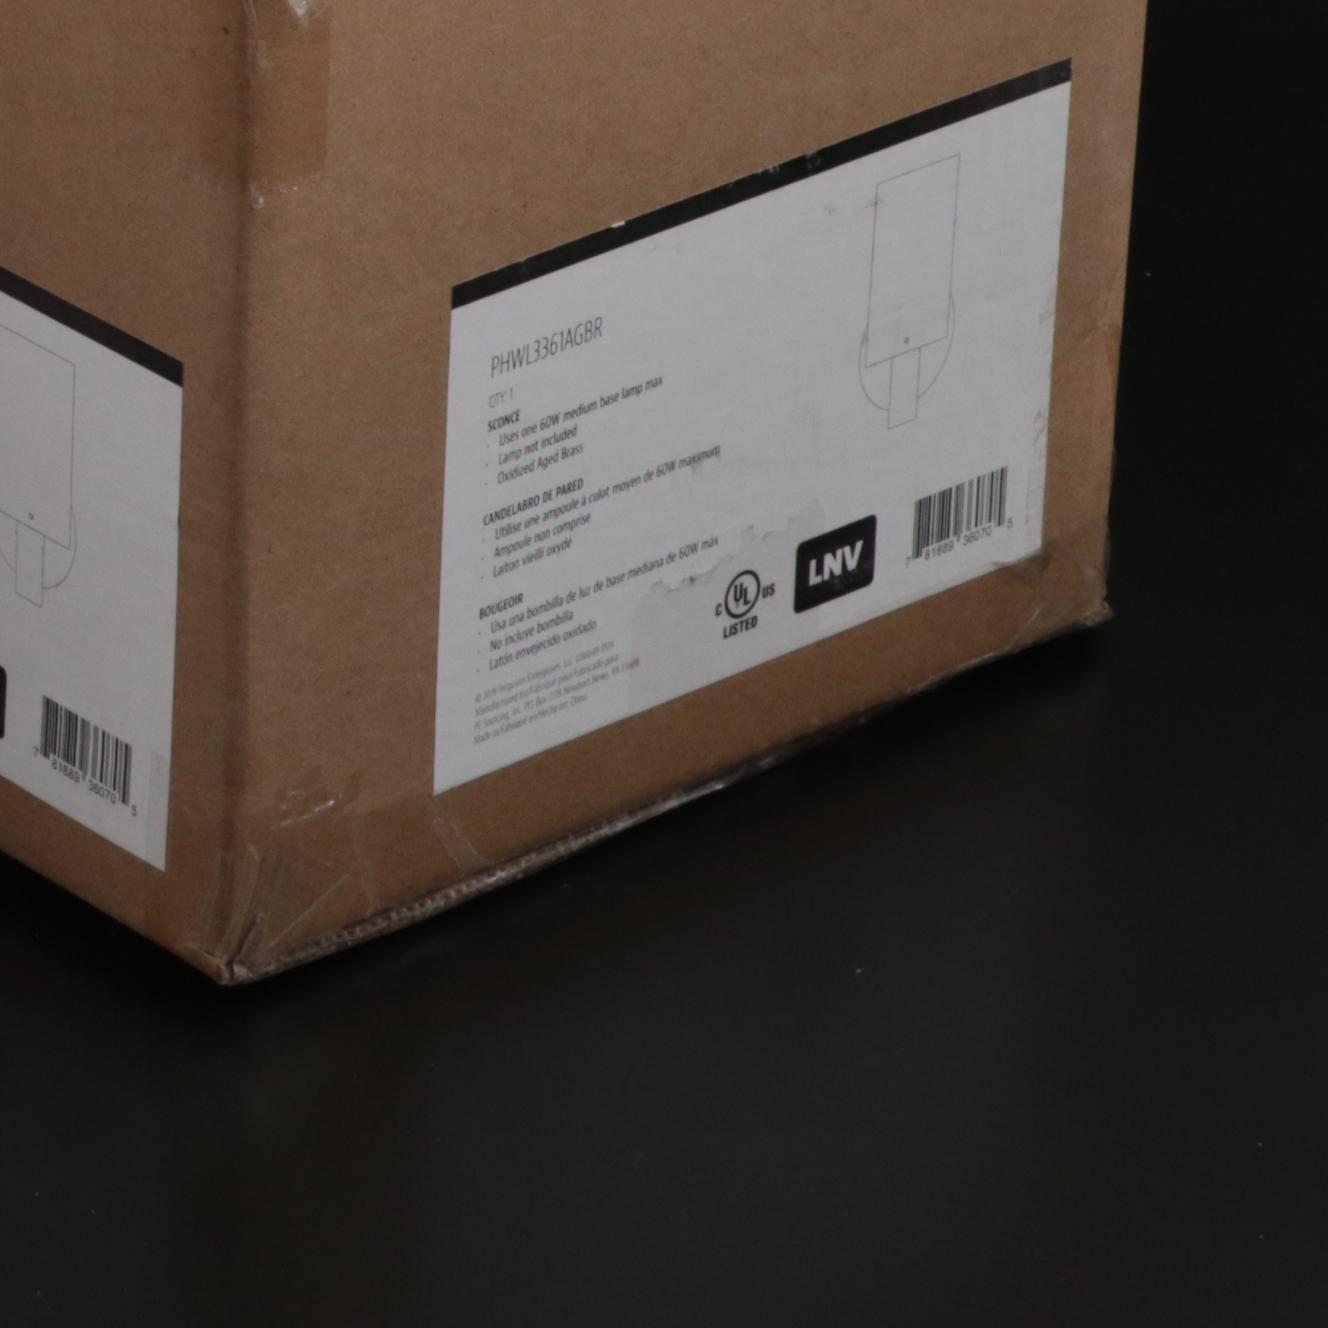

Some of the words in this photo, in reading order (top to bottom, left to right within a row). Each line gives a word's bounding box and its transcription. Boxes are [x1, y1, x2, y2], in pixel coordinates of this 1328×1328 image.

[491, 317, 603, 377] PHWL3361AGBR
[487, 410, 520, 432] SCONCE
[499, 431, 520, 447] Uses
[520, 423, 538, 438] one
[539, 413, 560, 431] 60W
[562, 401, 598, 422] medium
[599, 392, 620, 408] base
[621, 383, 644, 399] lamp
[645, 377, 663, 390] max
[497, 459, 535, 485] Oxidized
[536, 450, 560, 470] Aged
[560, 444, 584, 460] Brass
[498, 448, 523, 466] Lamp
[523, 440, 539, 455] not
[541, 424, 578, 448] included
[483, 495, 540, 526] CANDELABRO
[542, 489, 553, 504] DE
[555, 478, 584, 497] PARED
[494, 521, 522, 540] Utilise
[524, 515, 540, 529] une
[542, 499, 580, 522] ampoule
[588, 486, 610, 504] culot
[612, 475, 642, 494] moyen
[643, 469, 654, 483] de
[656, 460, 676, 478] 60W
[494, 536, 532, 558] Ampoule
[534, 529, 551, 543] non
[553, 513, 591, 536] comprise
[924, 540, 954, 561] 81889
[963, 525, 992, 546] 36070
[492, 559, 520, 578] Laiton
[521, 547, 545, 566] vieilli
[809, 540, 863, 585] LNV
[479, 593, 524, 620] BOUGEOIR
[490, 619, 507, 634] Usa
[508, 612, 525, 627] una
[526, 595, 564, 619] bombilla
[565, 590, 577, 604] de
[578, 586, 591, 599] luz
[592, 580, 604, 593] de
[605, 572, 626, 588] base
[627, 558, 664, 579] mediana
[665, 552, 677, 565] de
[678, 542, 699, 559] 60W
[733, 582, 751, 608] UL
[761, 583, 775, 599] US
[490, 639, 503, 651] No
[504, 626, 535, 647] incluye
[536, 610, 574, 634] bombilla
[514, 634, 561, 660] envejecido
[562, 620, 597, 642] oxidado
[723, 615, 758, 639] LISTED
